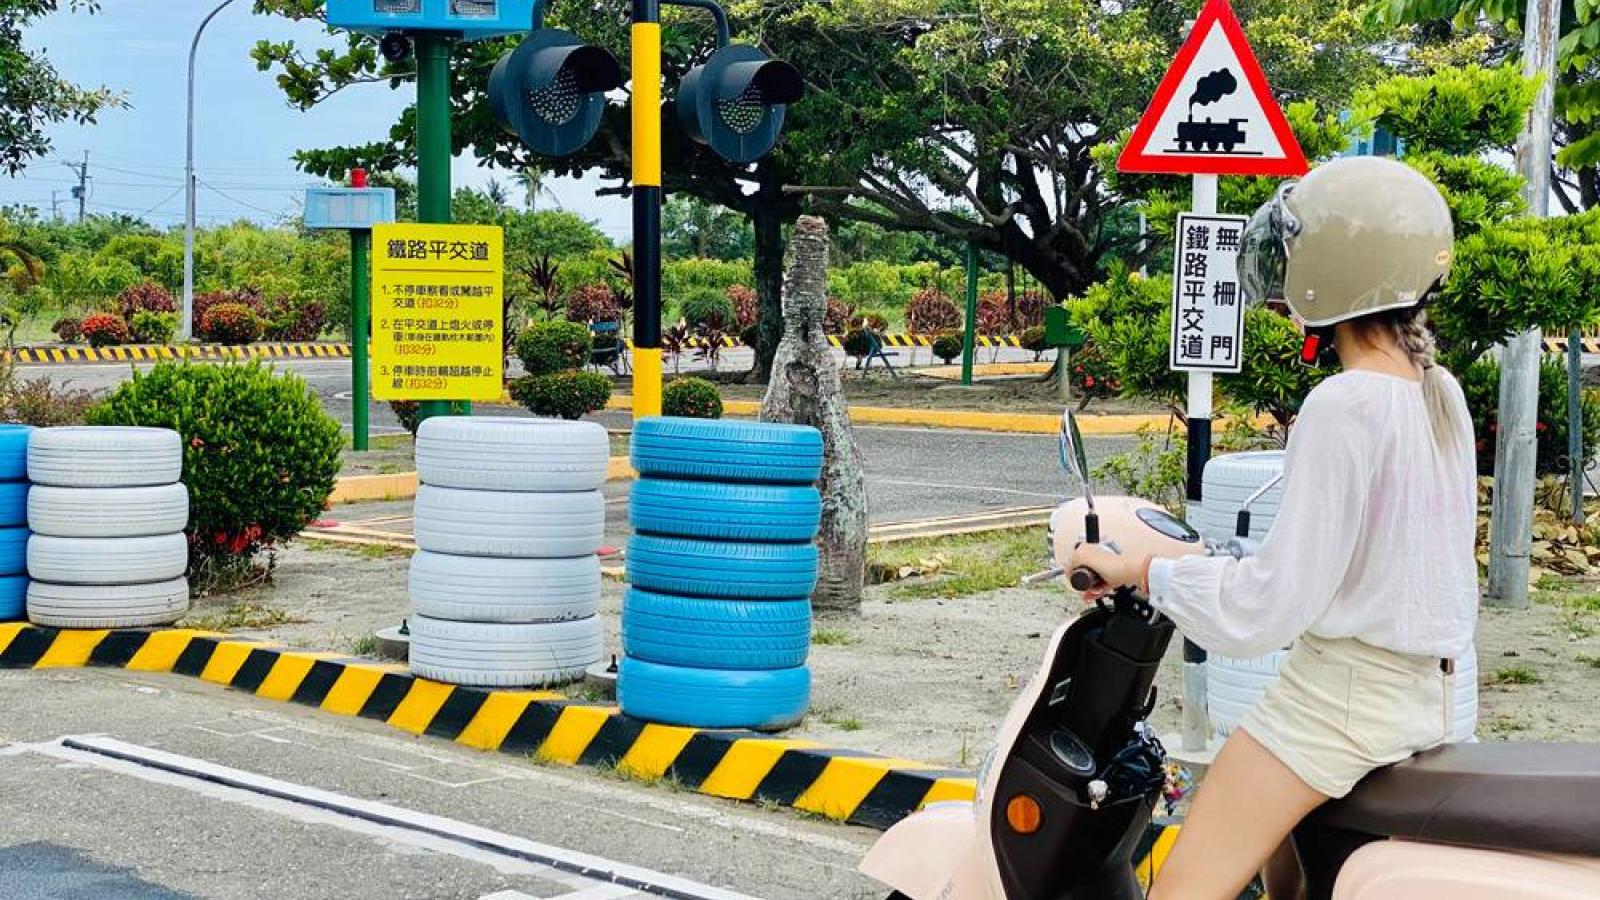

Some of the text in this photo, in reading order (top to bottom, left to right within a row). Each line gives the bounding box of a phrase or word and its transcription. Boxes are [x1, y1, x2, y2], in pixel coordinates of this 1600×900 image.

[387, 239, 489, 261] 鐵路平交道
[1180, 225, 1210, 360] 鐵路平交道
[1210, 227, 1240, 361] 無柵門
